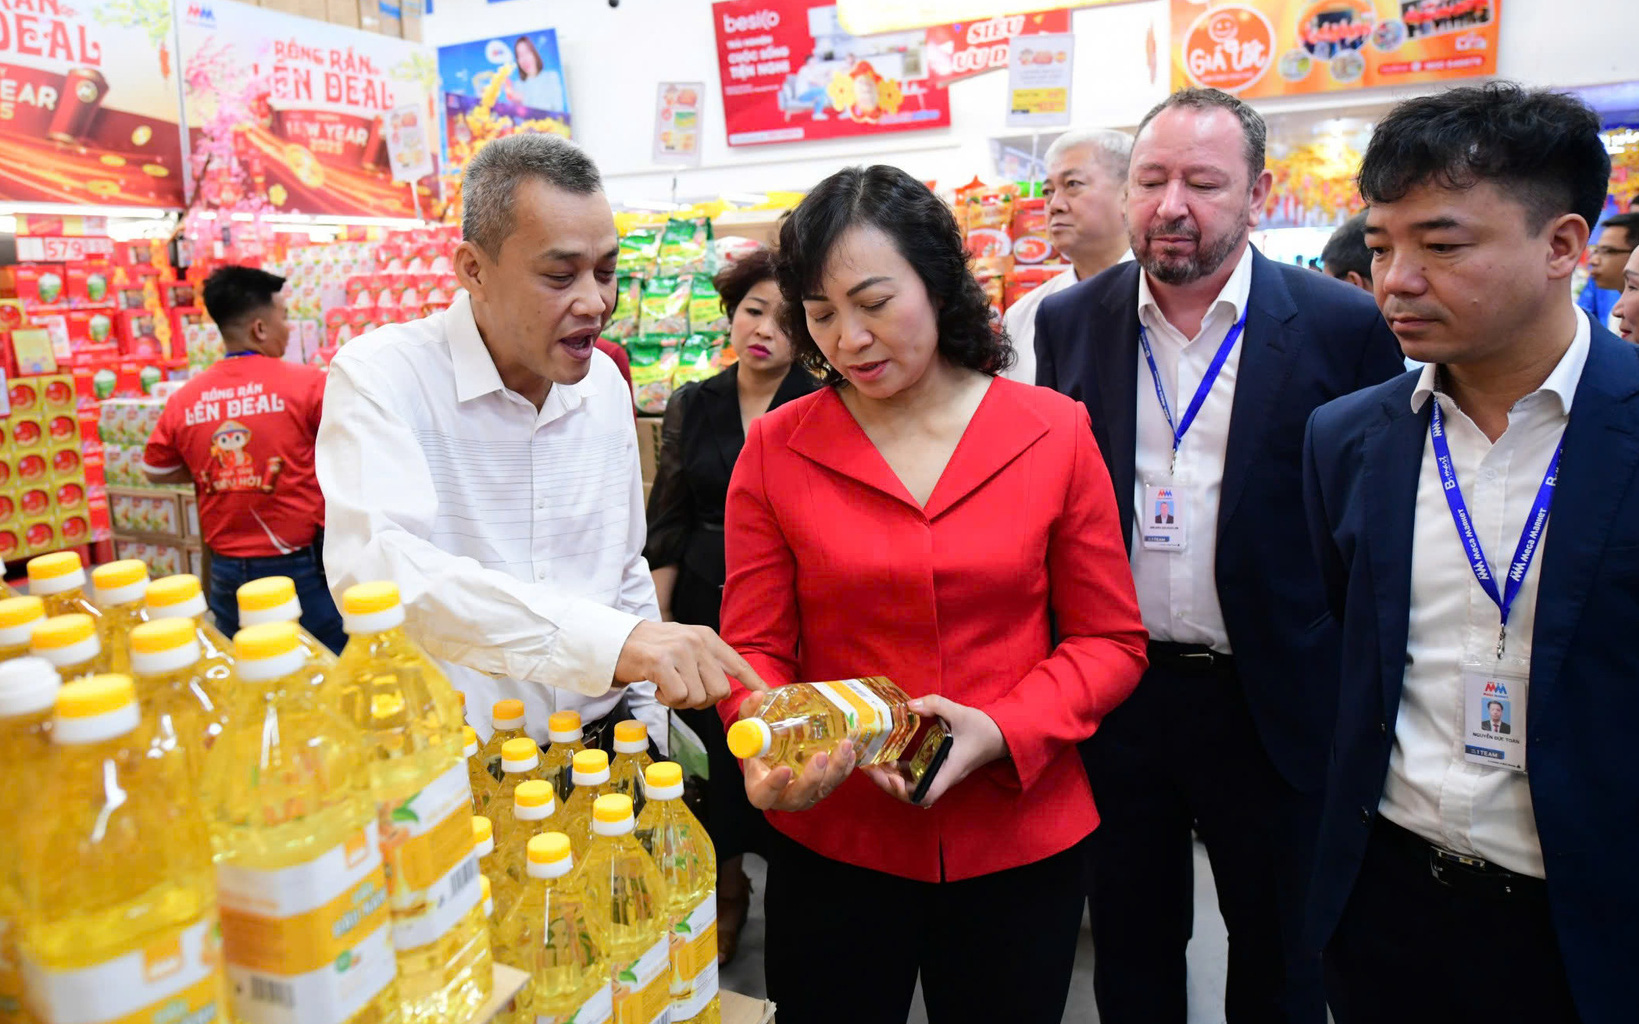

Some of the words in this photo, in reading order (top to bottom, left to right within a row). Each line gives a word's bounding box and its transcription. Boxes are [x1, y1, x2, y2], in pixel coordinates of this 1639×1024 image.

[325, 71, 395, 111] DEAL
[185, 400, 220, 426] LÊN
[226, 393, 285, 419] DEAL
